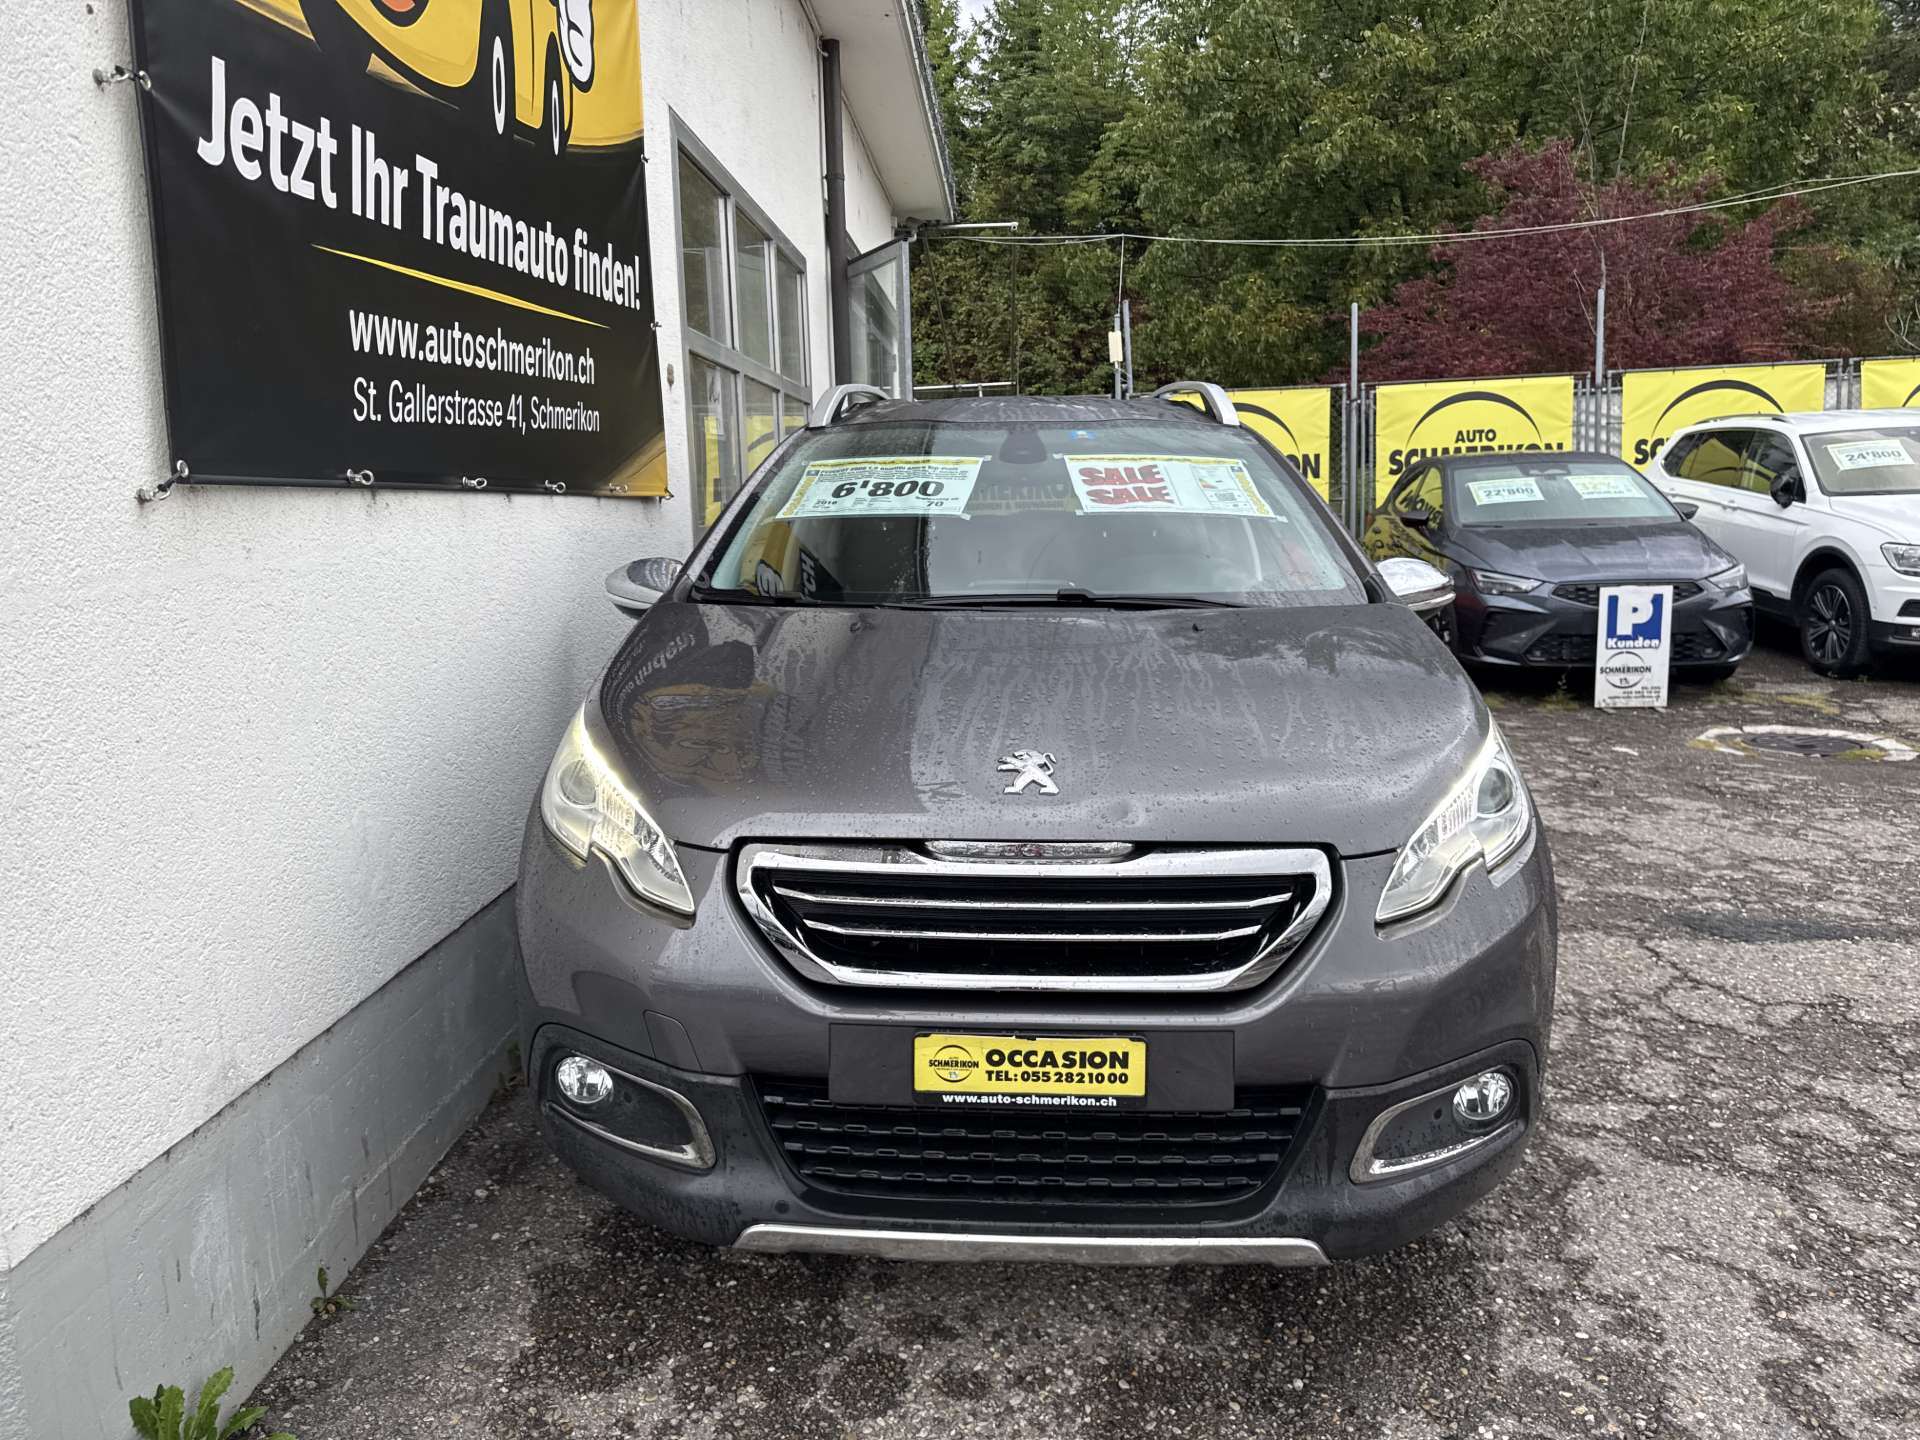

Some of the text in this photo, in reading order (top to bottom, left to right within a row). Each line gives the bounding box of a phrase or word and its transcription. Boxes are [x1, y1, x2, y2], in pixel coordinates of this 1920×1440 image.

[197, 56, 641, 311] Jetzt Ihr Traumauto finden!
[350, 310, 595, 385] www.autoschmerikon.ch
[353, 377, 600, 436] St. Gallerstrasse 41, Schmerikon
[1455, 429, 1497, 444] AUTO
[1845, 449, 1902, 462] 24'800
[1078, 464, 1165, 487] SALE
[831, 480, 945, 499] 6'800
[1086, 485, 1175, 505] SALE
[1616, 593, 1654, 636] P
[1607, 637, 1660, 649] Kunden
[1600, 666, 1652, 674] SCHMERIKON
[928, 1058, 979, 1069] SCHMERIKON
[985, 1049, 1129, 1069] OCCASION
[985, 1070, 1018, 1081] TEL:
[1020, 1071, 1051, 1082] 055
[942, 1093, 1117, 1107] www.auto-schmerikon.ch
